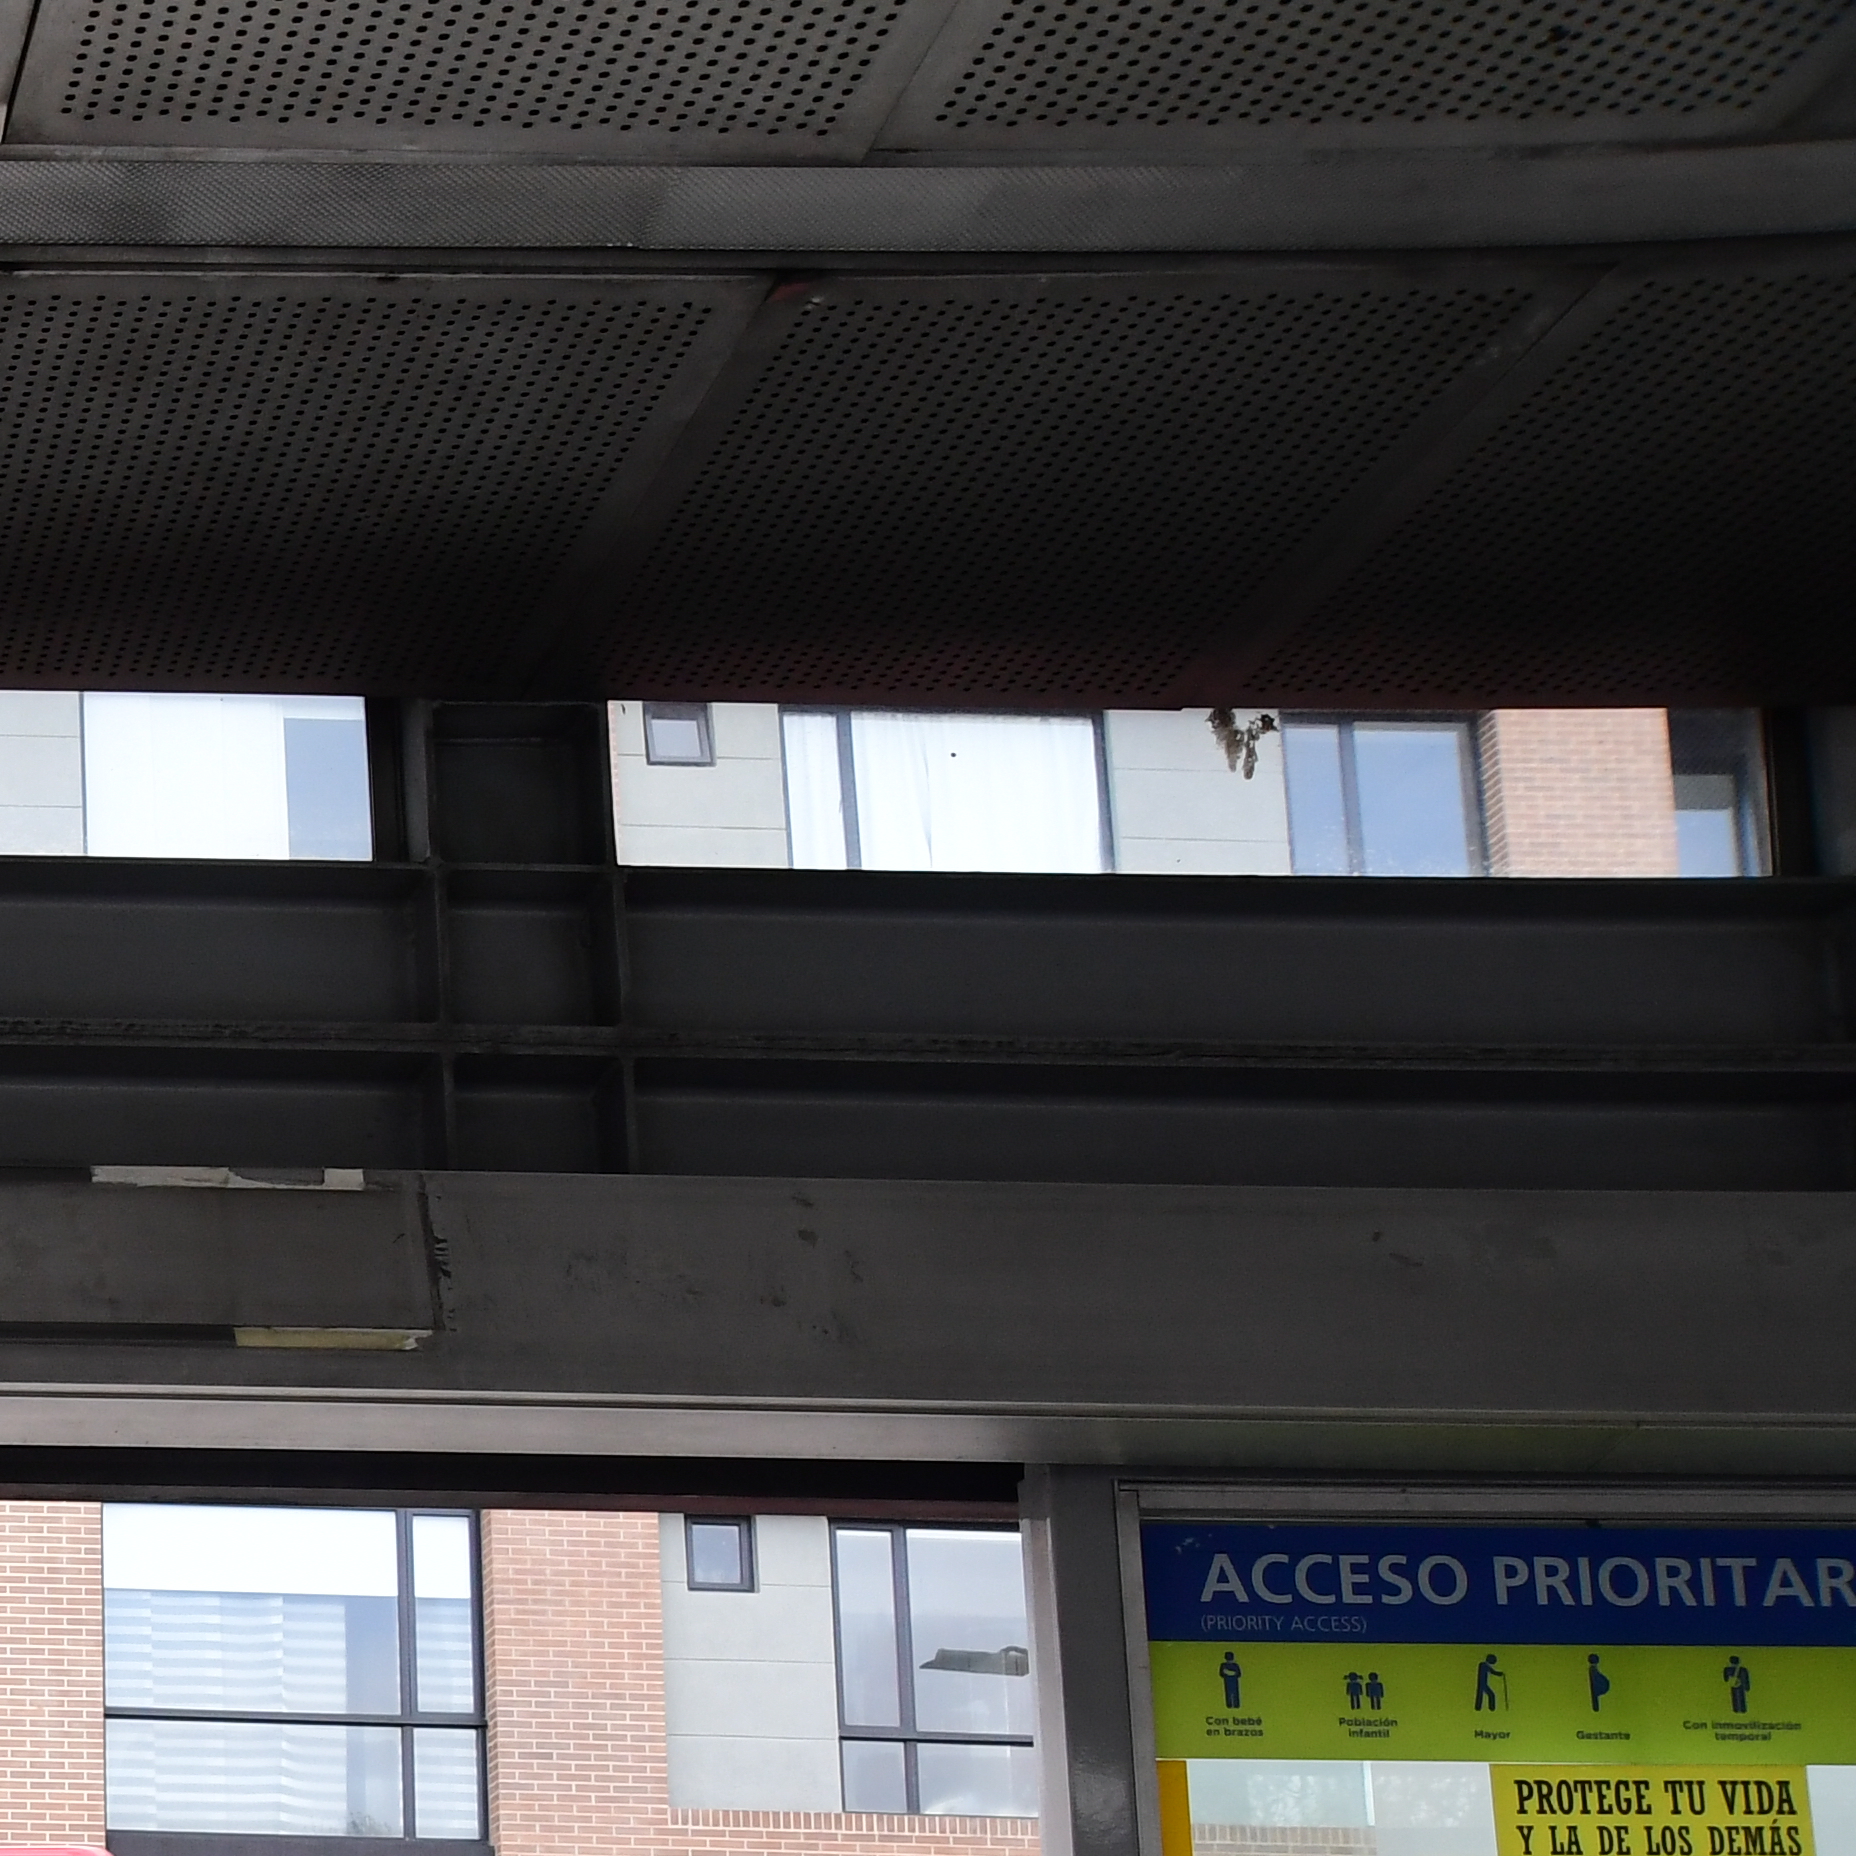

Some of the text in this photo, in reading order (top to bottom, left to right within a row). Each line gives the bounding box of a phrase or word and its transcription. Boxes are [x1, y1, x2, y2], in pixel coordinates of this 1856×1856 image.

[1199, 1553, 1856, 1607] ACCESO PRIORITAR
[1200, 1614, 1368, 1634] (PRIORITY ACCESS)
[1205, 1716, 1230, 1726] Con
[1338, 1717, 1398, 1728] Población
[1682, 1720, 1708, 1730] Con
[1223, 1727, 1264, 1737] brazos
[1348, 1728, 1390, 1738] infantil
[1474, 1729, 1511, 1741] Mayor
[1575, 1730, 1631, 1741] Gestante
[1513, 1779, 1798, 1816] PROTEGE TU VIDA
[1515, 1818, 1803, 1856] Y LA DE LOS DEMÁS
